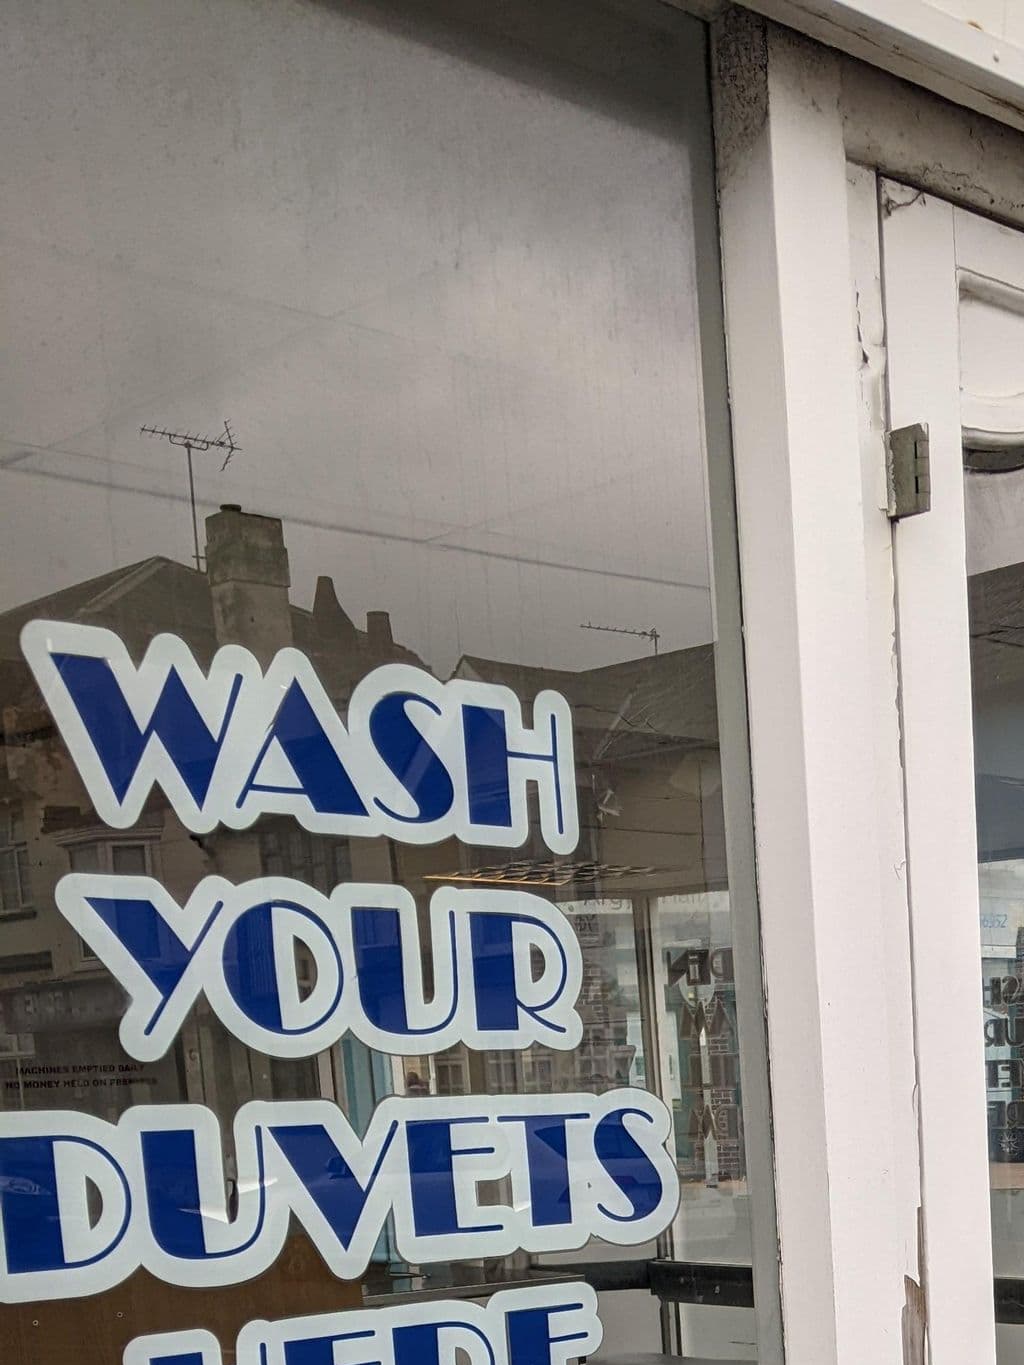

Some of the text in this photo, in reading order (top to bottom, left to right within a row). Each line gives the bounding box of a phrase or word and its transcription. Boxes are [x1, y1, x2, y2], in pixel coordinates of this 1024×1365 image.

[20, 619, 580, 855] WASH
[55, 873, 584, 1062] YOUR
[23, 1079, 61, 1090] MONEY
[92, 1078, 108, 1088] ON
[0, 1087, 681, 1303] DUVETS
